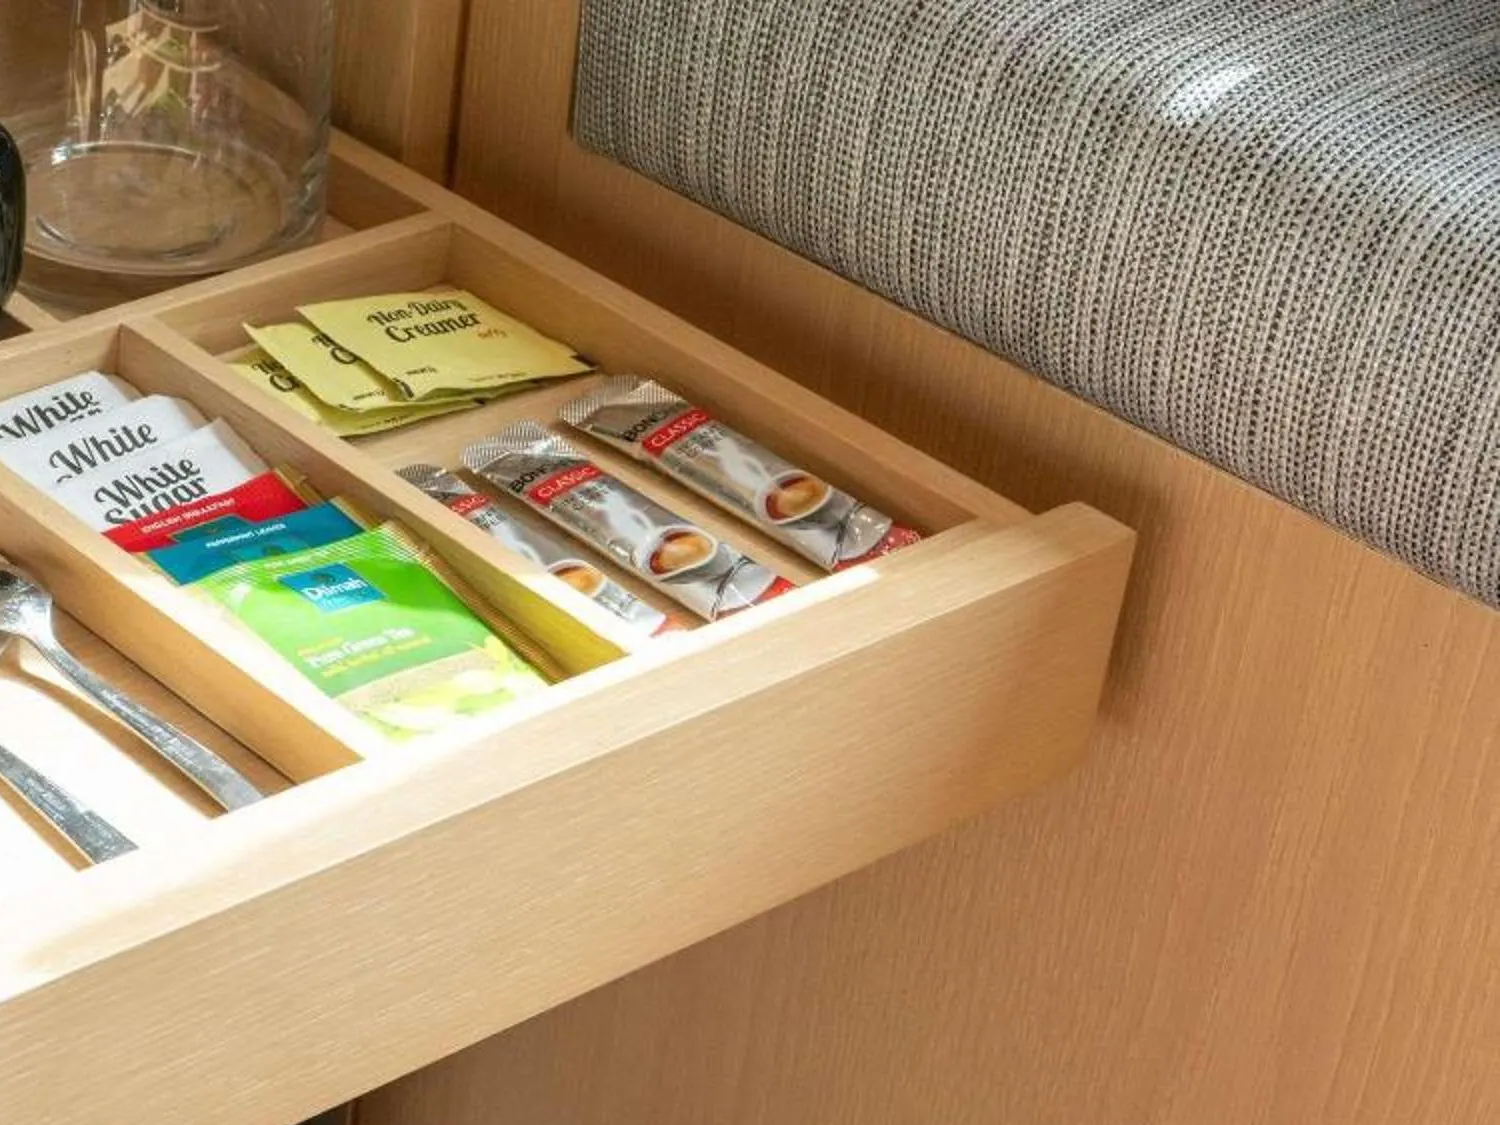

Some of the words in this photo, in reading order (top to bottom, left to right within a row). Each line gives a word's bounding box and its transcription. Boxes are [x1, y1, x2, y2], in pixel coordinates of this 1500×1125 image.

[366, 299, 467, 326] Non-Dairy
[385, 312, 481, 343] Creamer
[49, 422, 158, 475] White
[94, 457, 201, 509] White
